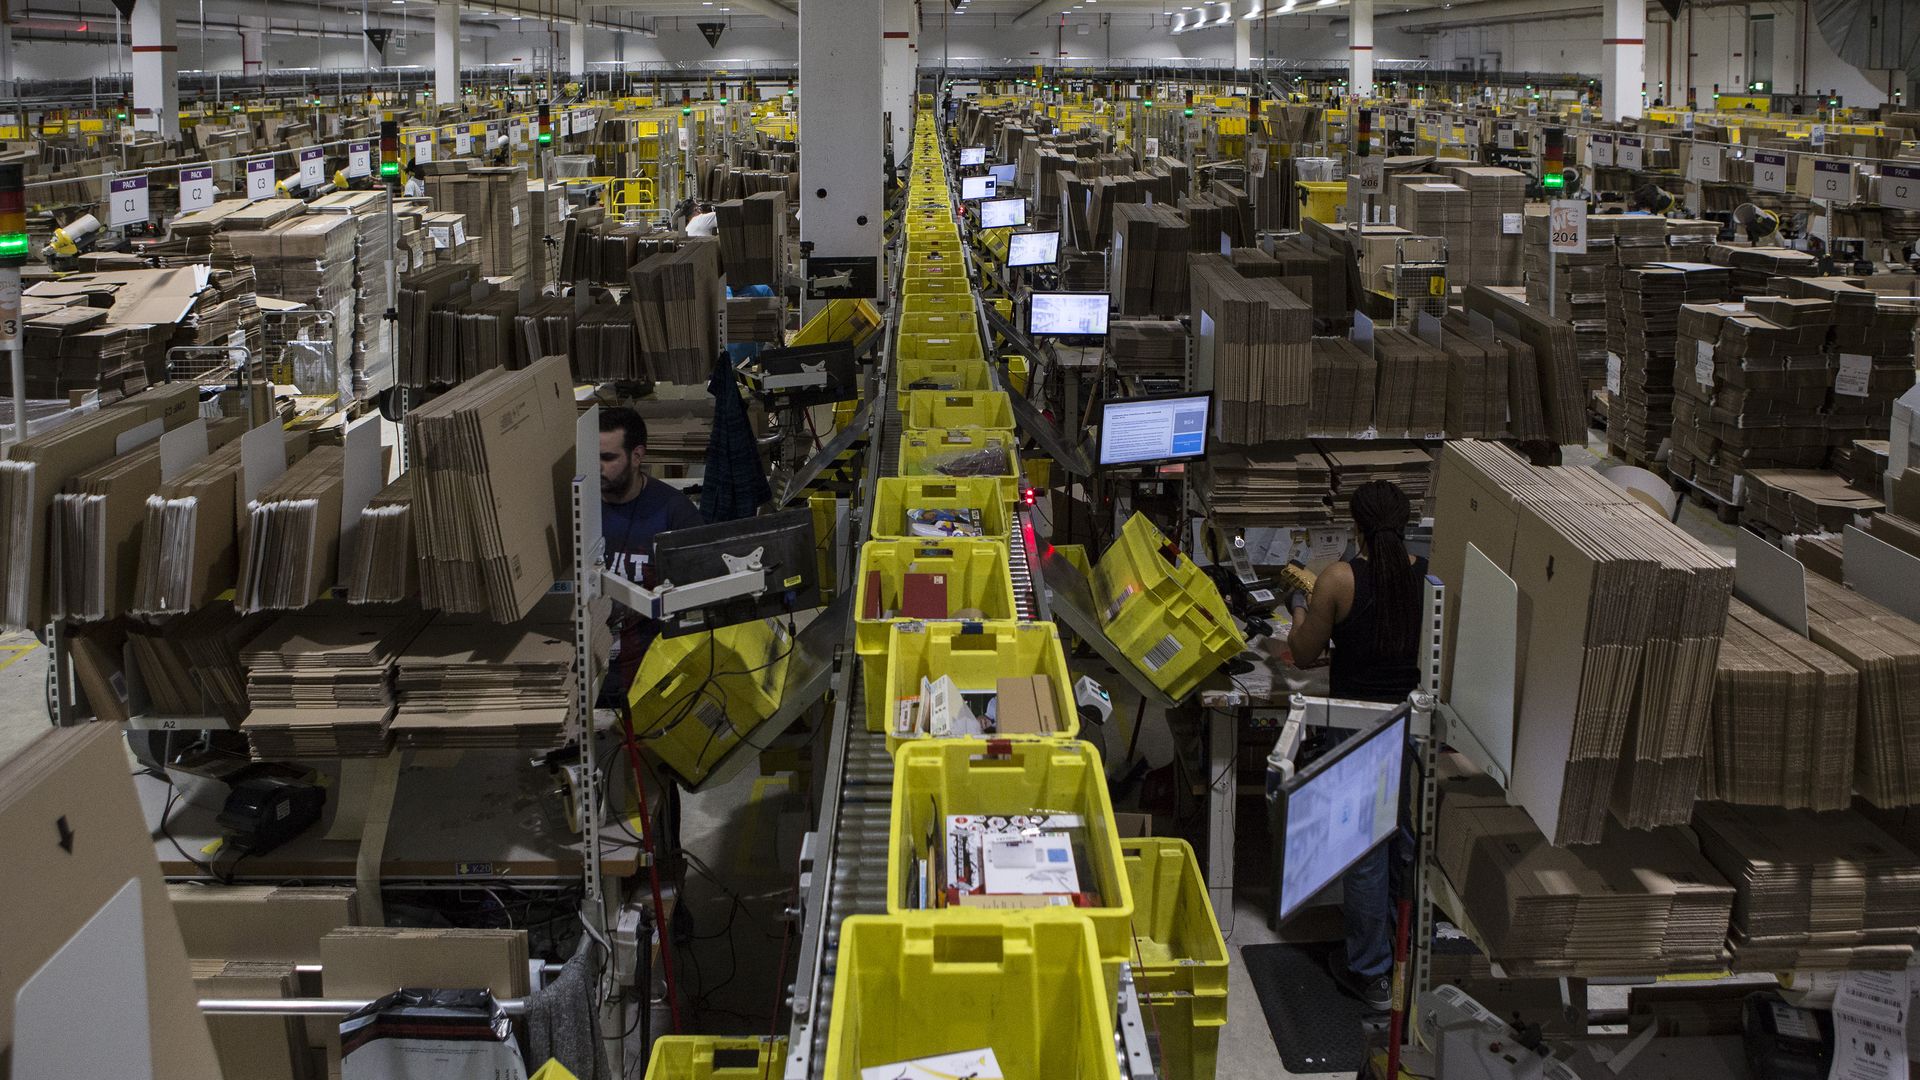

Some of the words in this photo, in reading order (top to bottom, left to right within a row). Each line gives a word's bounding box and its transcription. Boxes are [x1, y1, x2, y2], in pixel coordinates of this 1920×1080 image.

[190, 170, 203, 179] PACK
[1764, 170, 1774, 182] C4
[1894, 168, 1909, 178] PACK
[122, 180, 137, 189] PACK
[257, 178, 266, 189] C3
[1361, 179, 1379, 188] 206
[1826, 179, 1837, 191] C3
[192, 188, 202, 201] C2
[1895, 186, 1907, 199] C2
[124, 199, 136, 212] C1
[1552, 232, 1579, 243] 204
[0, 319, 17, 335] 3
[554, 582, 568, 592] E6
[163, 720, 176, 730] A2
